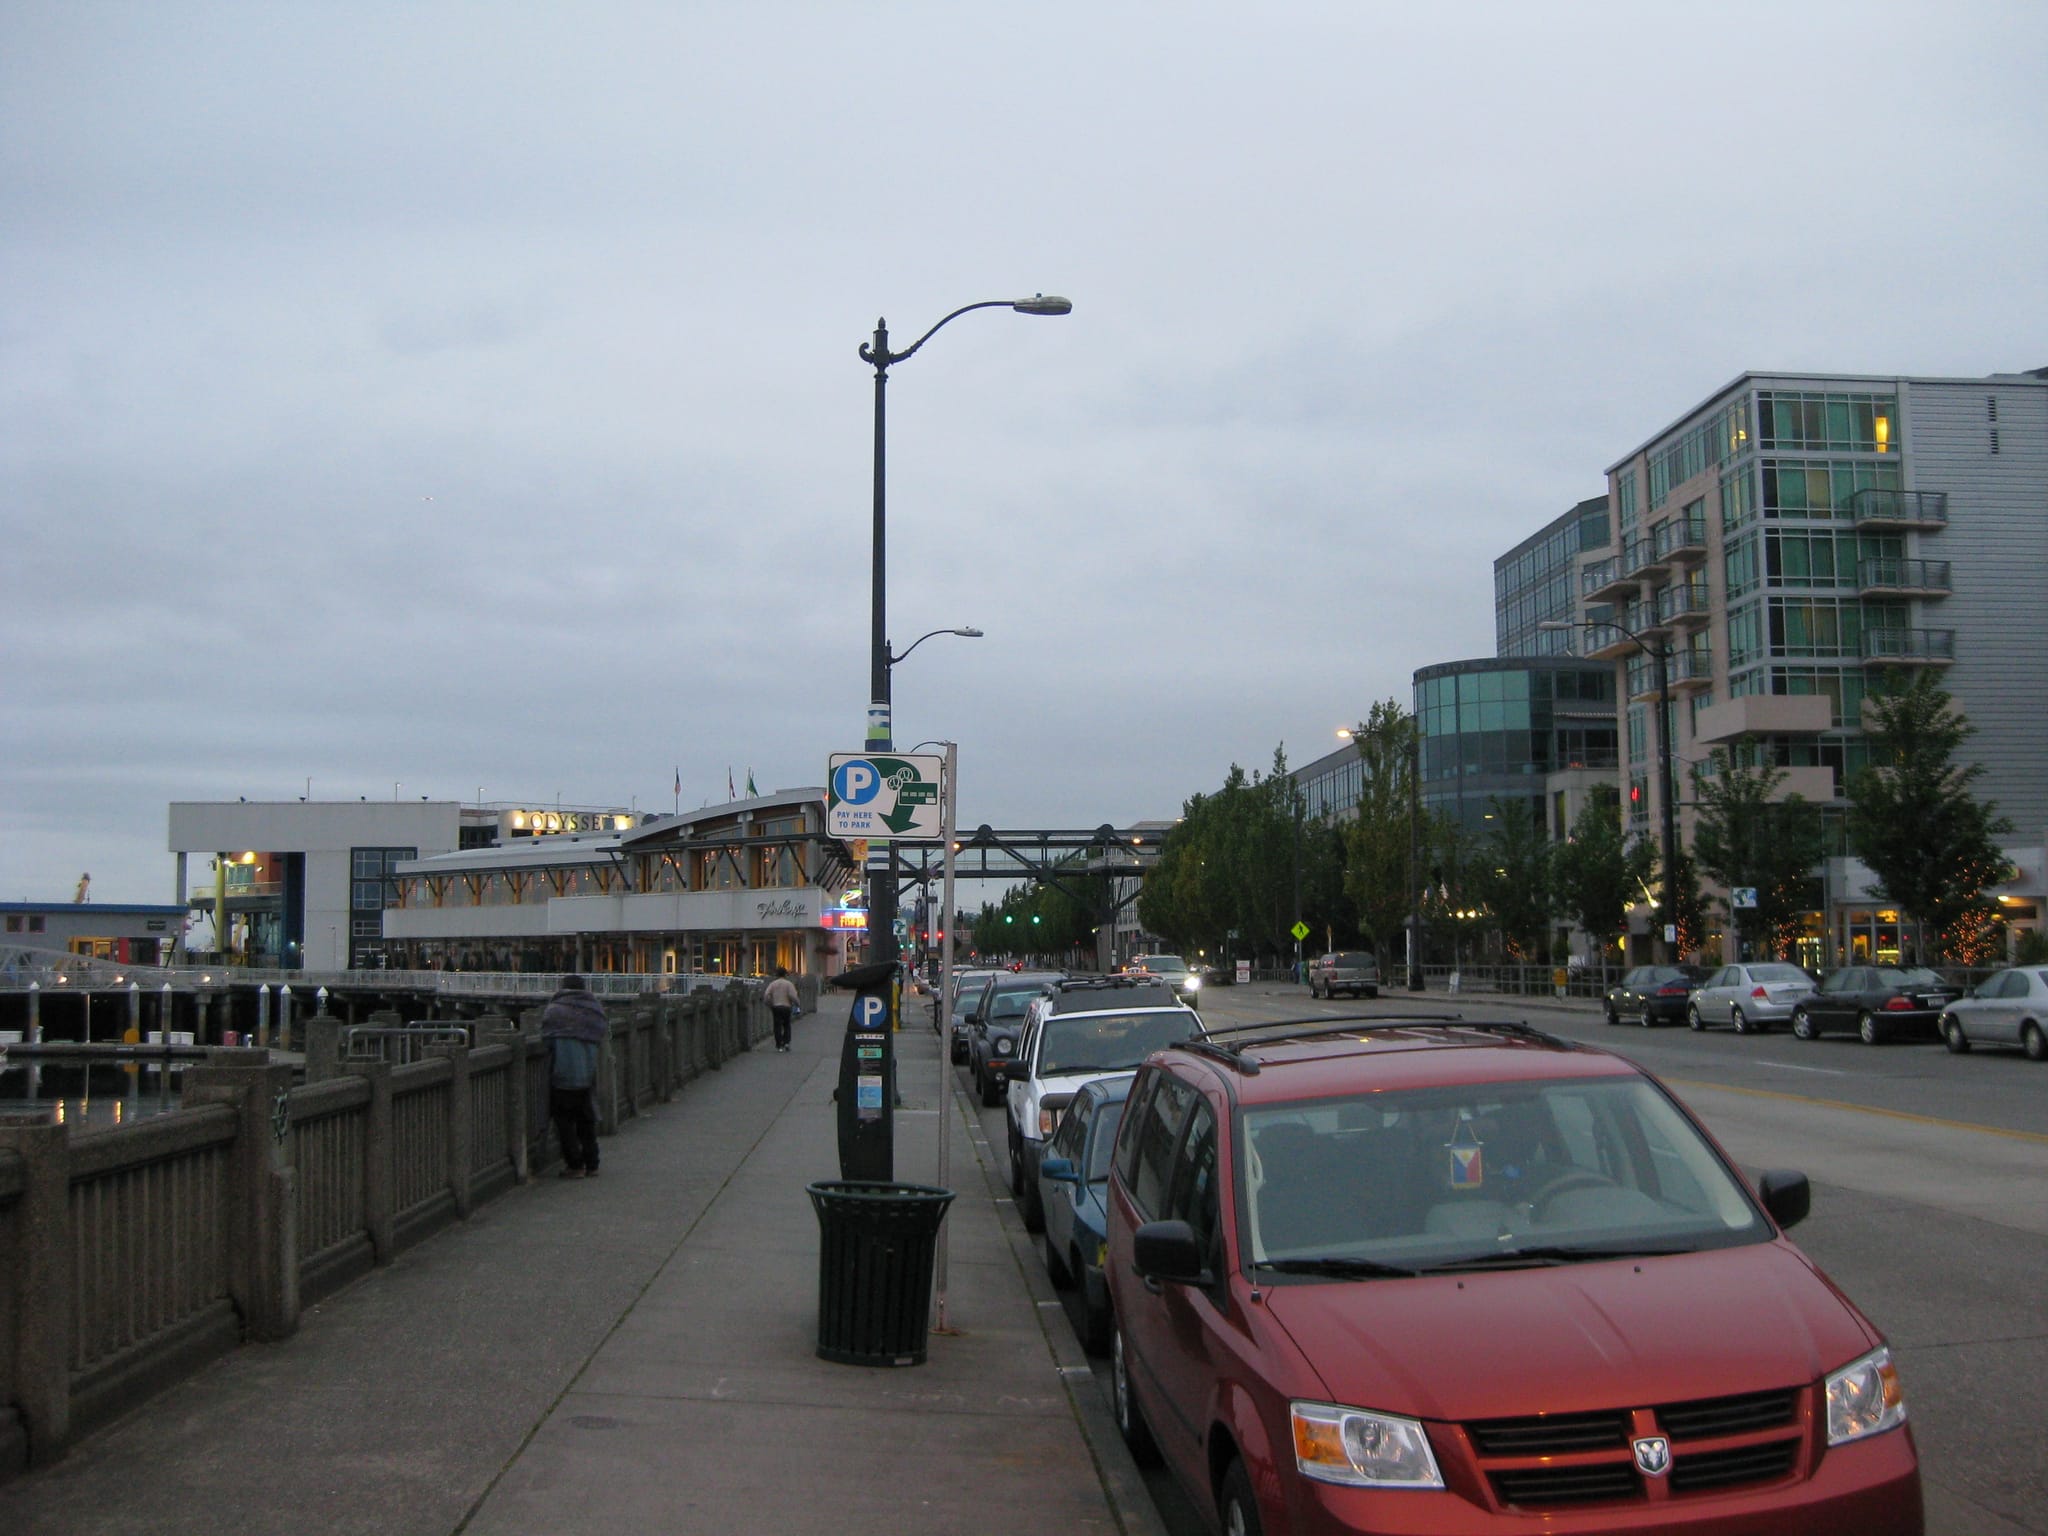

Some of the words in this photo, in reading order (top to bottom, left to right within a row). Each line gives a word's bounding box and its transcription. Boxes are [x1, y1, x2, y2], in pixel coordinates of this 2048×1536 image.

[846, 767, 872, 800] P
[530, 813, 604, 831] ODYSSE
[837, 811, 850, 819] PAY
[853, 811, 873, 819] HERE
[839, 821, 848, 829] TO
[851, 821, 871, 829] PARK
[864, 997, 883, 1025] P
